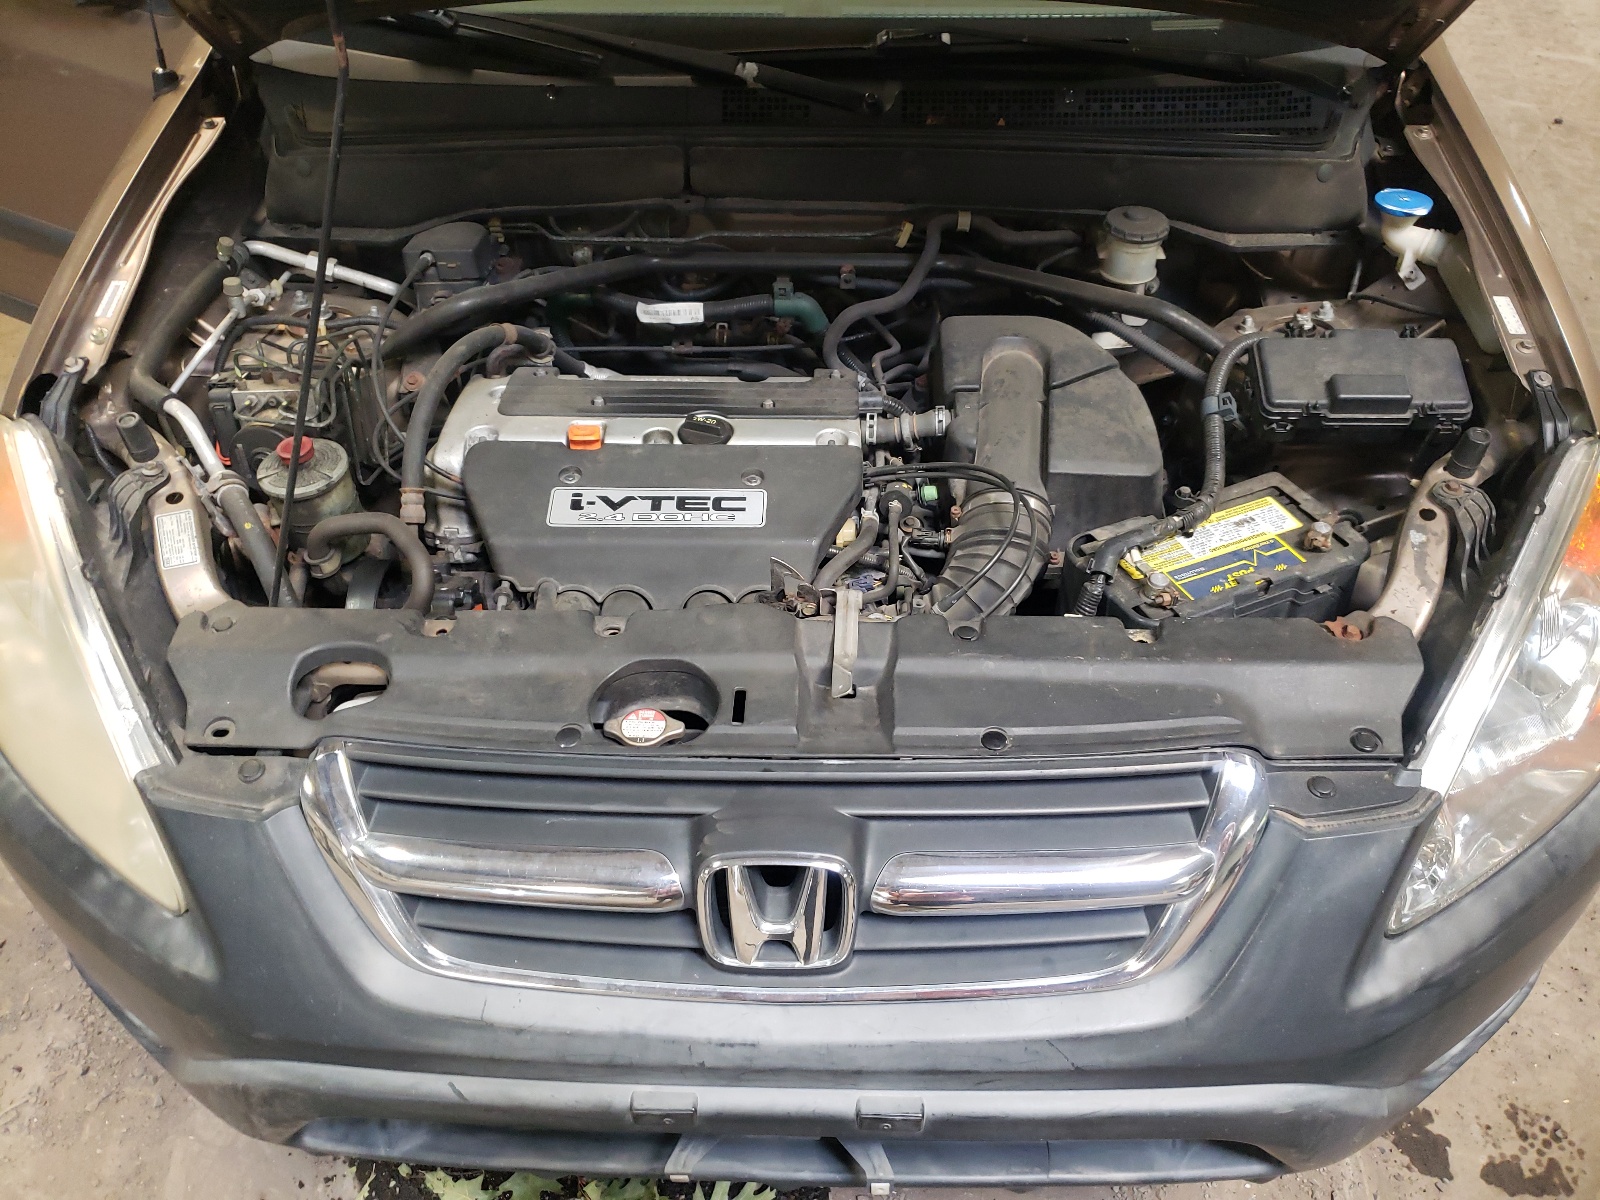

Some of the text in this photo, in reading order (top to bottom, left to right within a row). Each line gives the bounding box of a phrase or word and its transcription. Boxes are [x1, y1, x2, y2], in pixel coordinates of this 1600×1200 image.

[570, 492, 747, 512] i-VTEC
[577, 512, 736, 522] 2.4 DOHC
